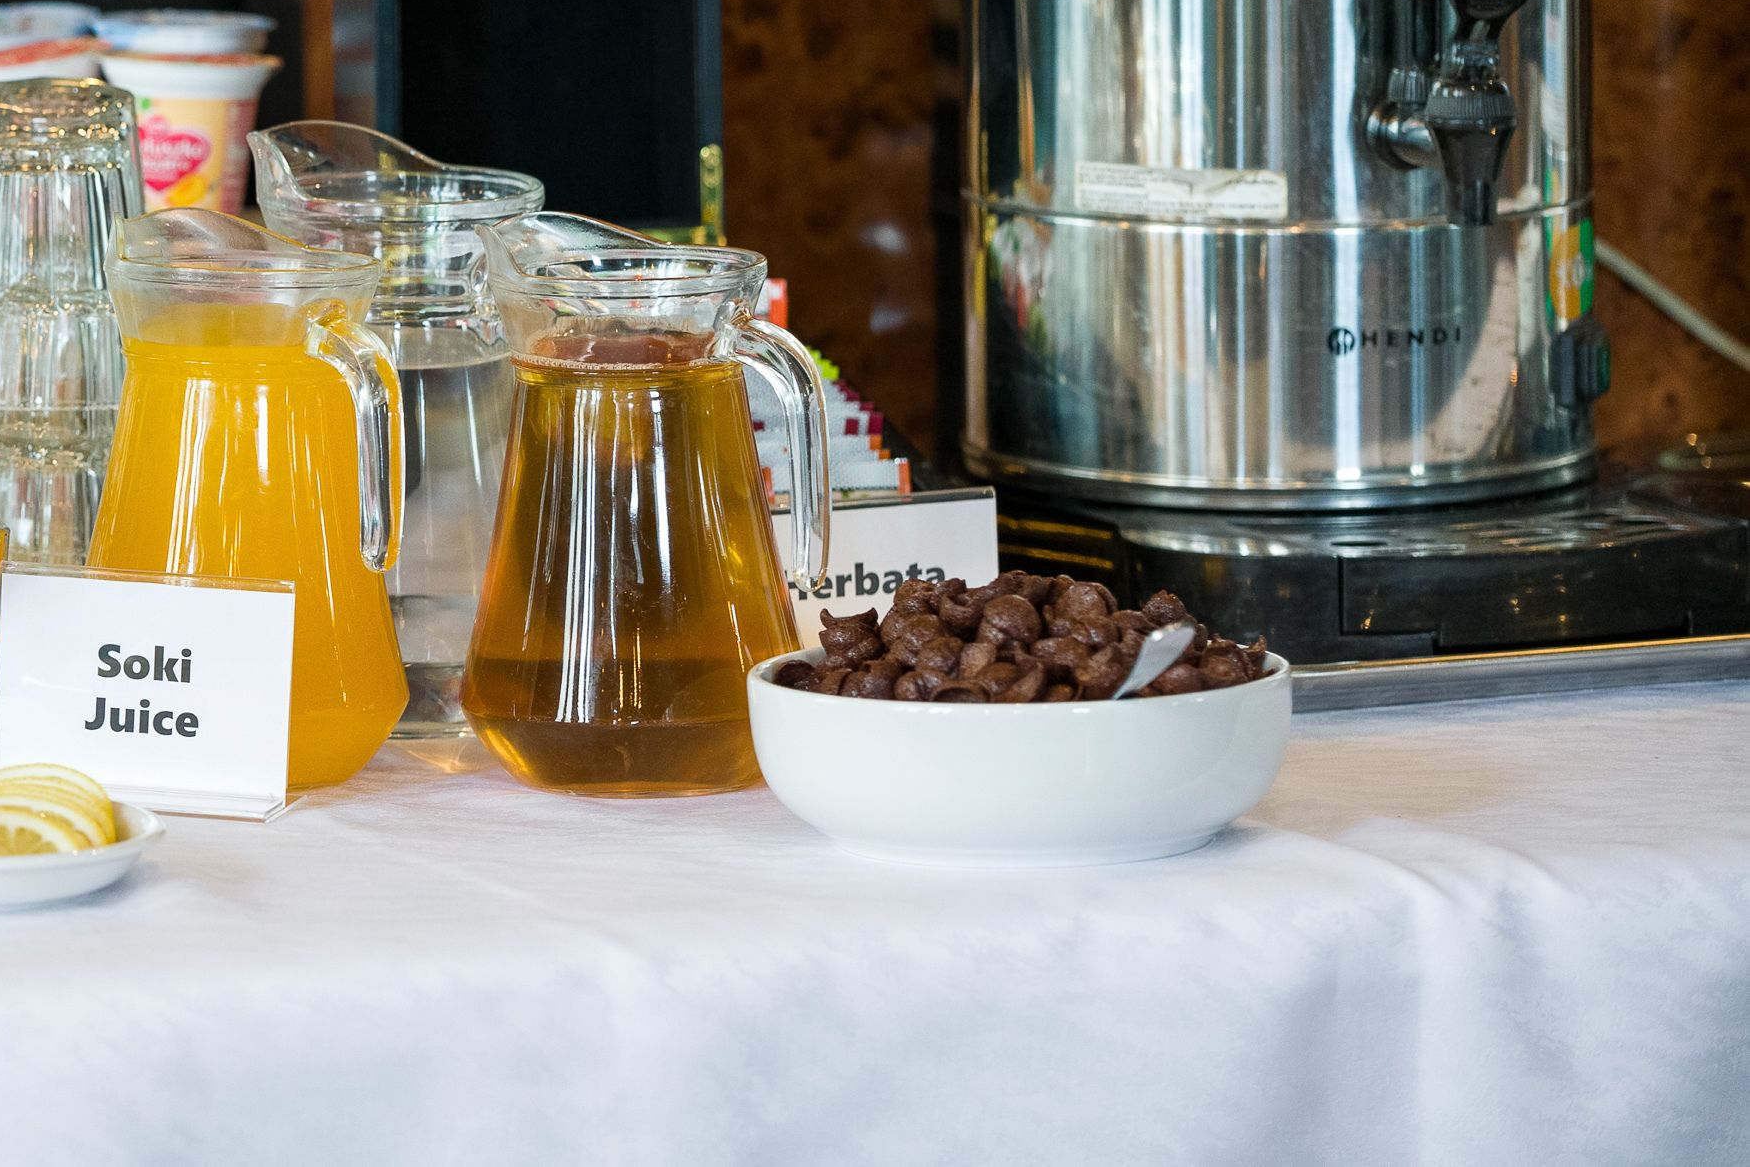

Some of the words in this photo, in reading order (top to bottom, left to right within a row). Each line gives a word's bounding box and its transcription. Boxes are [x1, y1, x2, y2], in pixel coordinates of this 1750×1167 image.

[1361, 326, 1461, 347] HENDI
[97, 643, 192, 683] Soki
[84, 697, 199, 737] Juice
